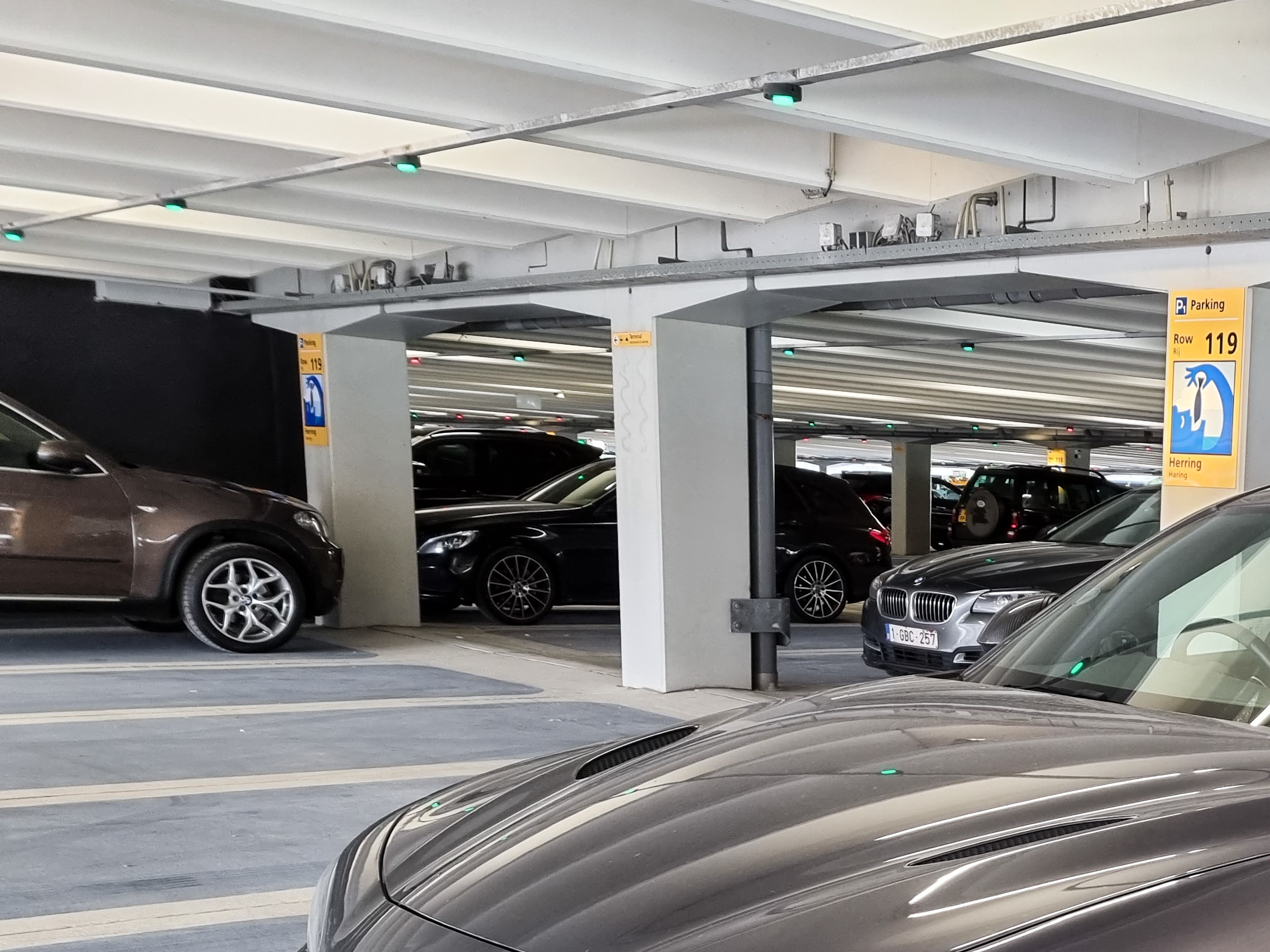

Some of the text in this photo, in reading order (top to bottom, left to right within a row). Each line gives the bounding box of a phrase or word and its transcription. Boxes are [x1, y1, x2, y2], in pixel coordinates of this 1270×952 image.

[1191, 298, 1225, 312] Parking
[1173, 331, 1238, 355] Row 119
[310, 358, 322, 371] 119
[1169, 457, 1202, 471] Herring
[1169, 471, 1188, 480] Haring
